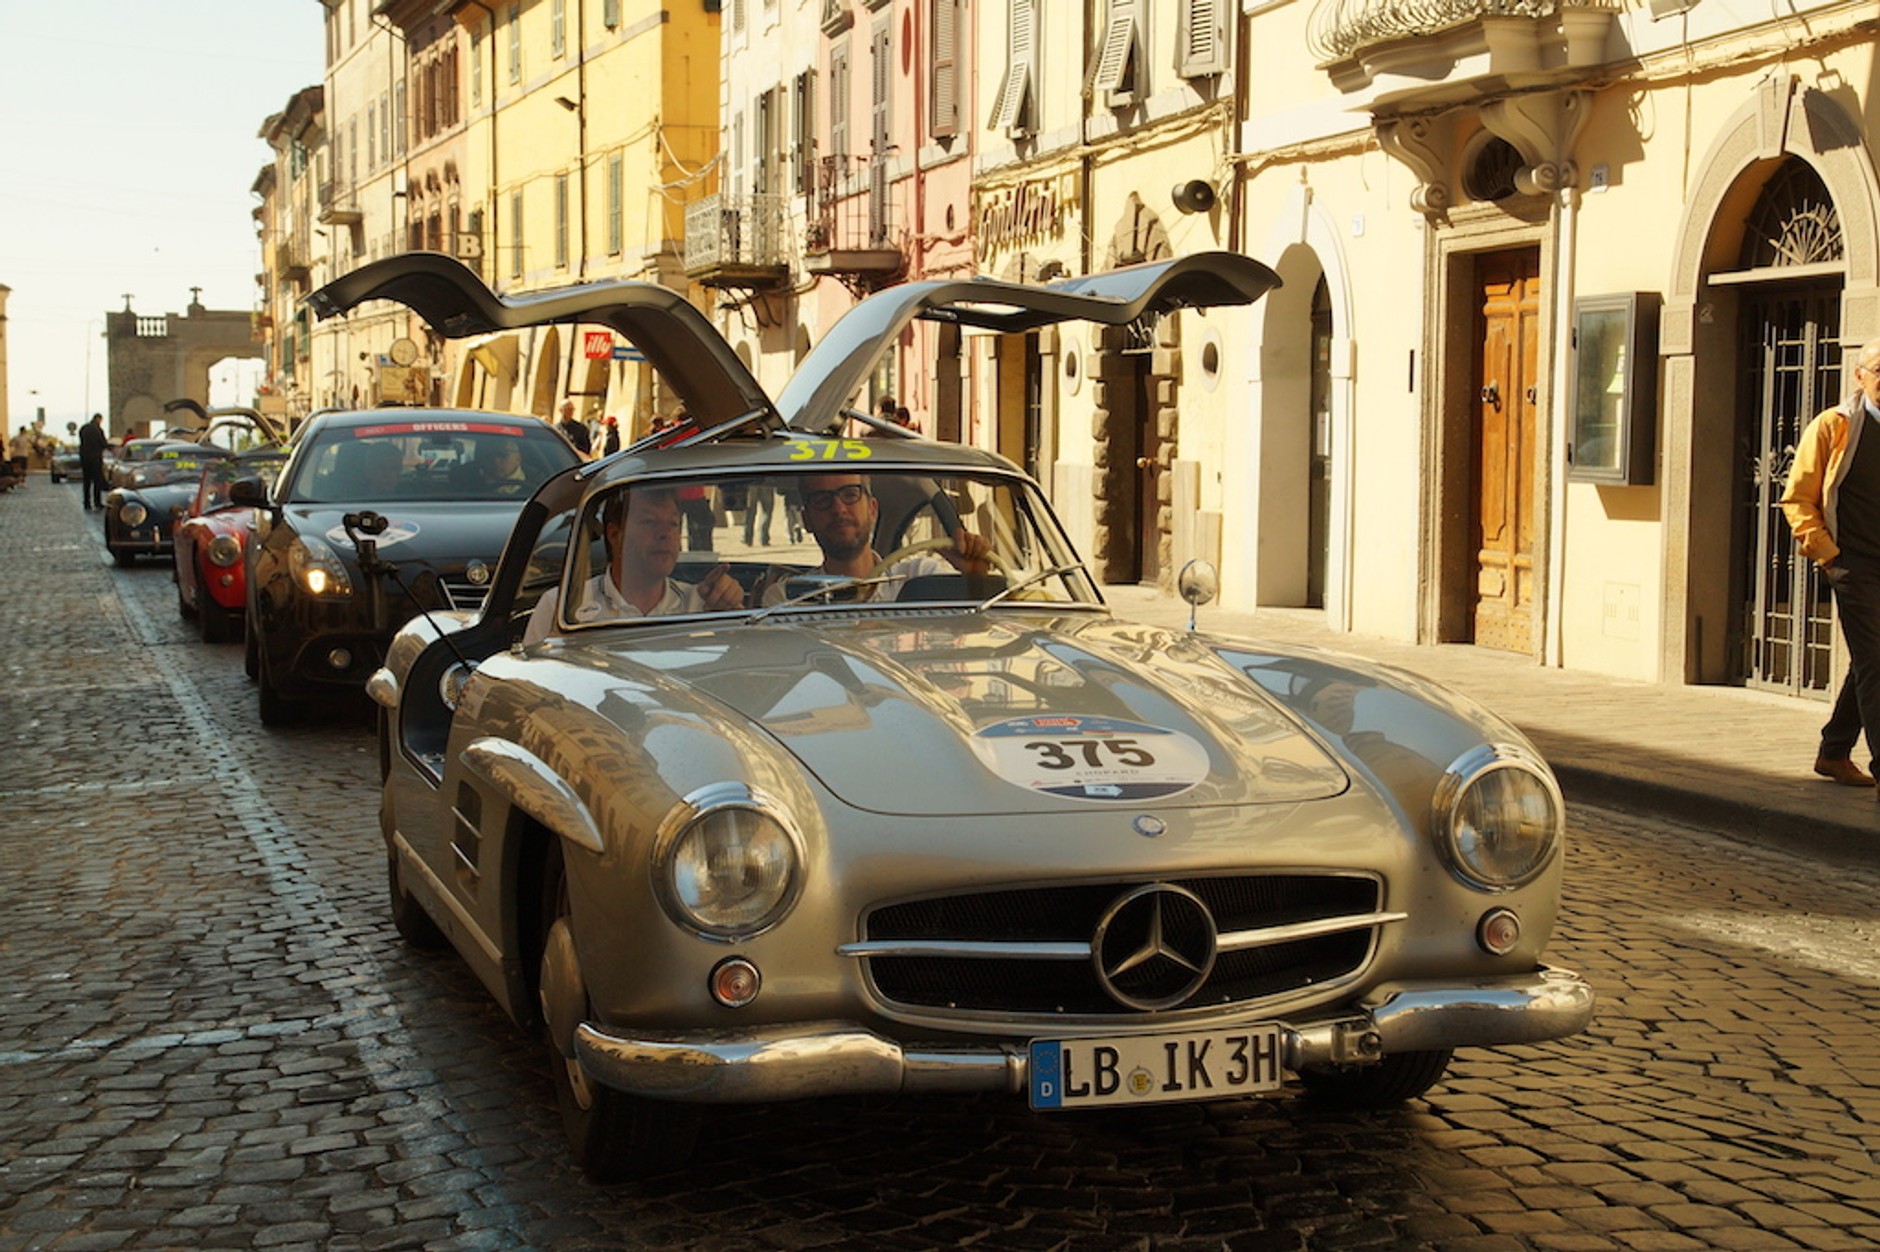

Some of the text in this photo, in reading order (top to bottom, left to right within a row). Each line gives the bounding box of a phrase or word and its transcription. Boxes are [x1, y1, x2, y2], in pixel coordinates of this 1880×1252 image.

[457, 234, 481, 257] B
[586, 334, 611, 358] illy
[412, 422, 468, 432] OFFICERS
[783, 440, 872, 461] 375
[1024, 739, 1155, 770] 375
[1063, 1033, 1277, 1097] LB IK 3H
[1041, 1081, 1053, 1097] D
